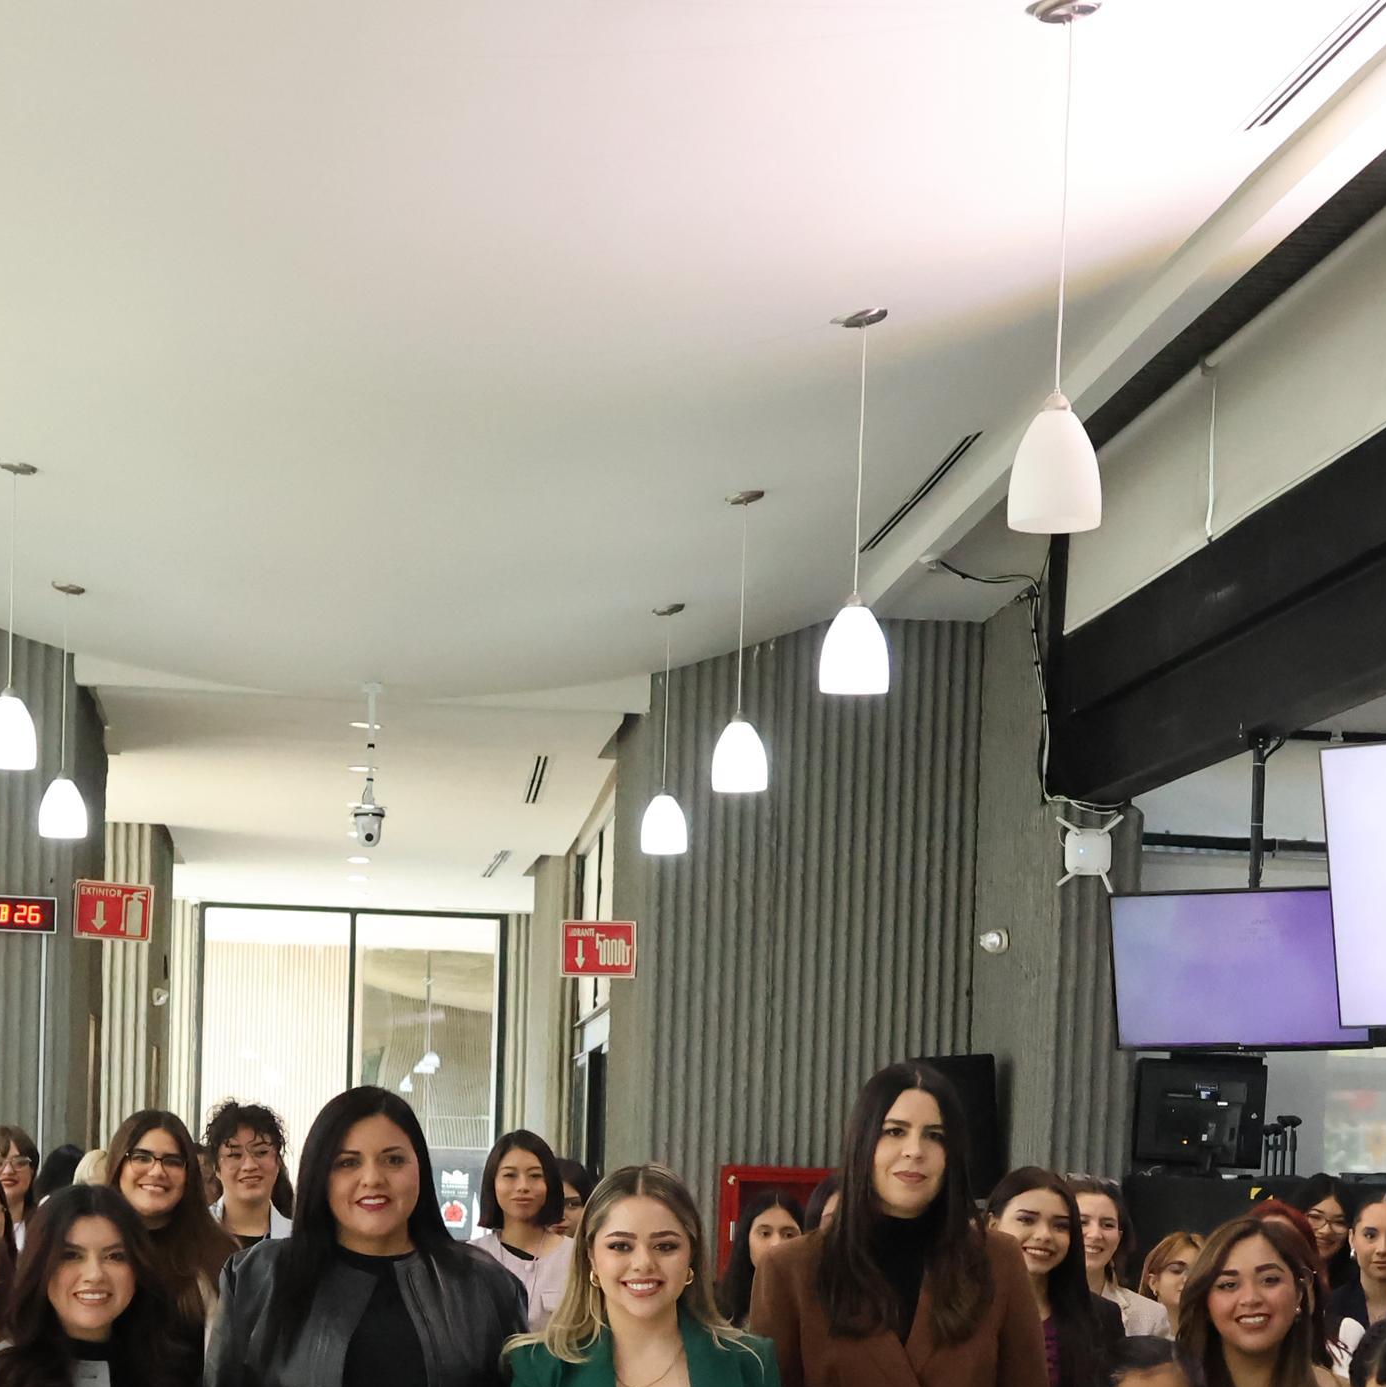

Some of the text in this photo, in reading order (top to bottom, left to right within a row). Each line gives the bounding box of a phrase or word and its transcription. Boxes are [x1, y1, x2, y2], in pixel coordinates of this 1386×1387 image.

[80, 886, 122, 898] EXTINTOR
[13, 904, 42, 924] 26
[567, 927, 595, 938] DRANTE
